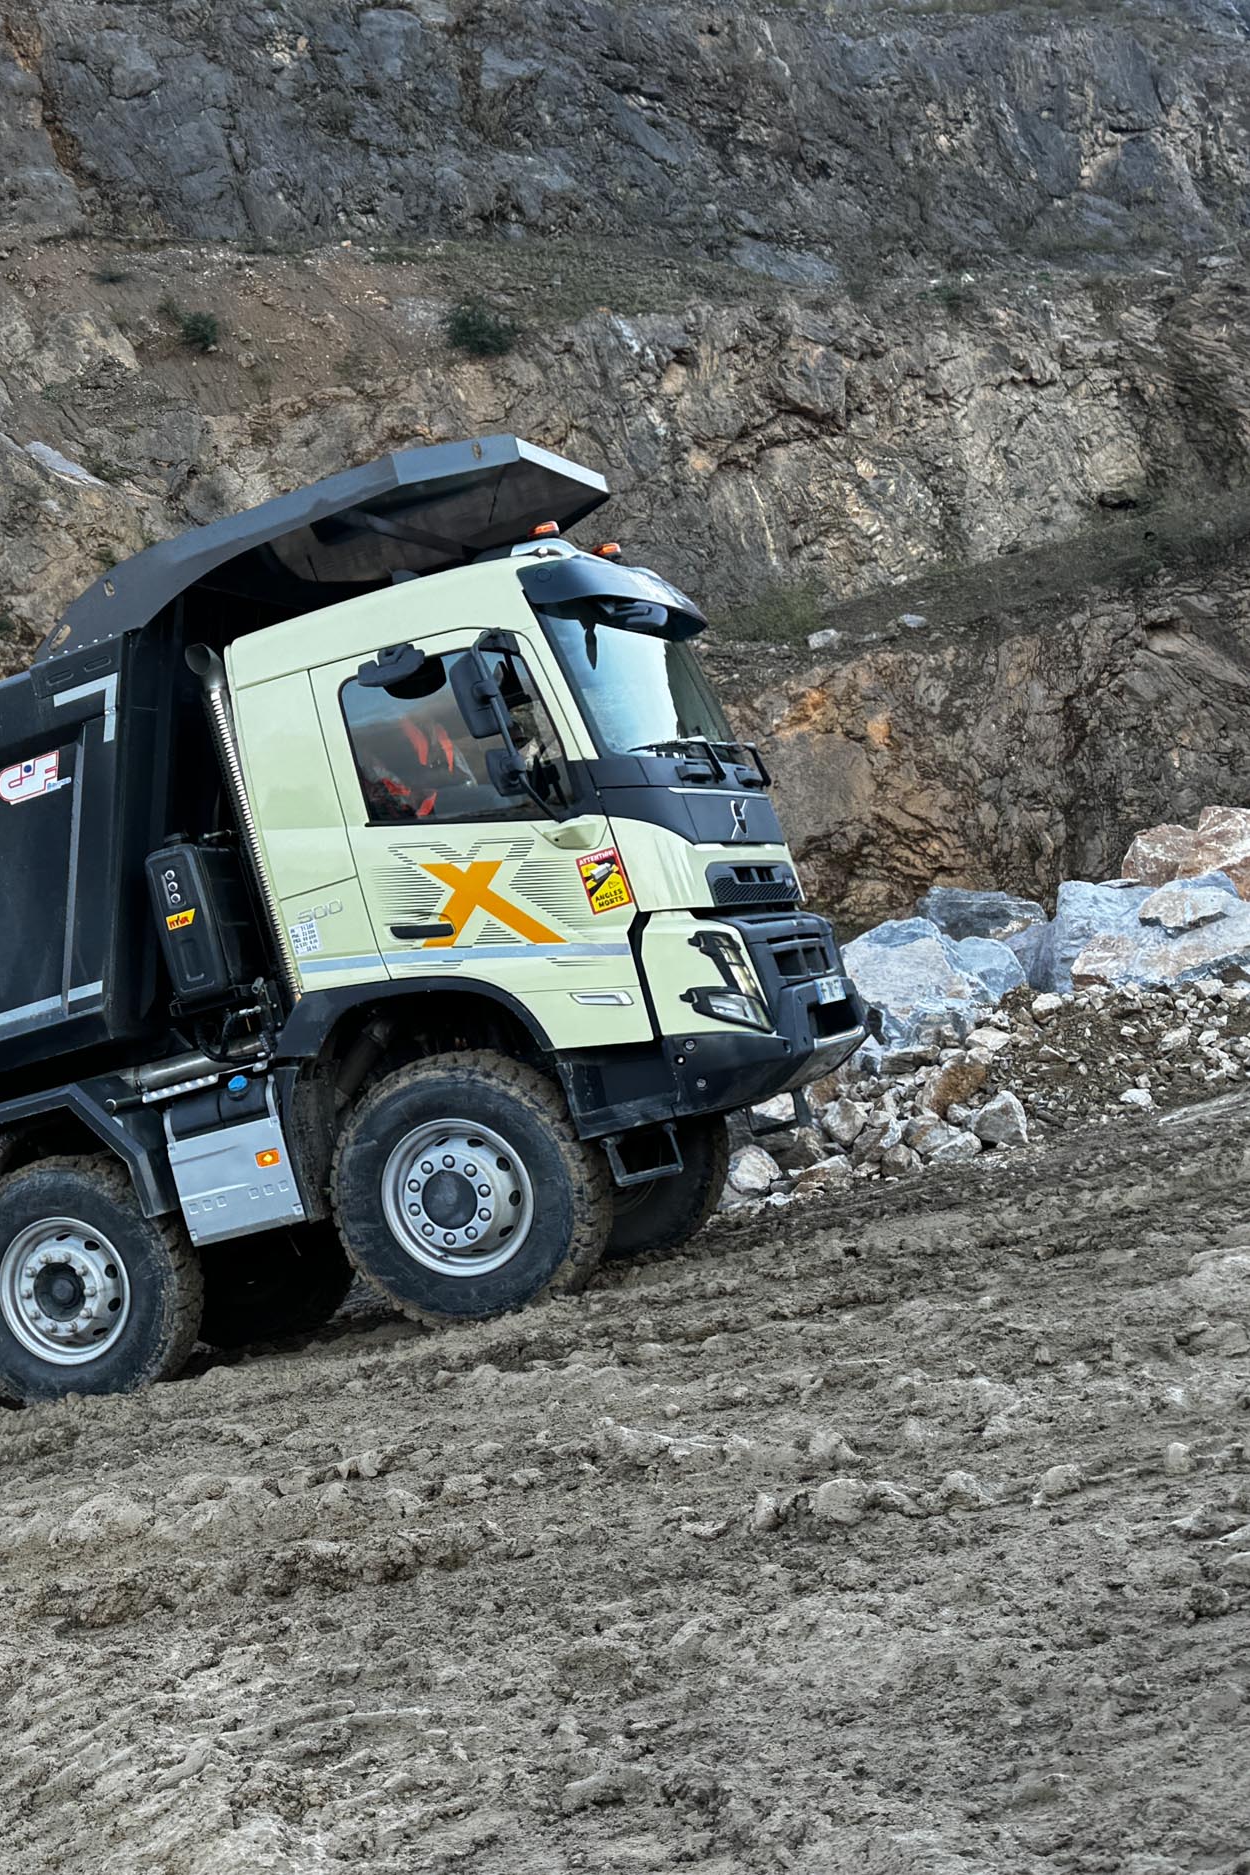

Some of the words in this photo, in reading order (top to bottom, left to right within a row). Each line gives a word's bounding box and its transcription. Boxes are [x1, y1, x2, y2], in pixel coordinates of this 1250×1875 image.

[578, 849, 615, 866] ATTENTION
[595, 888, 623, 903] ANGLES
[598, 895, 625, 908] MORTS
[297, 899, 343, 924] 500
